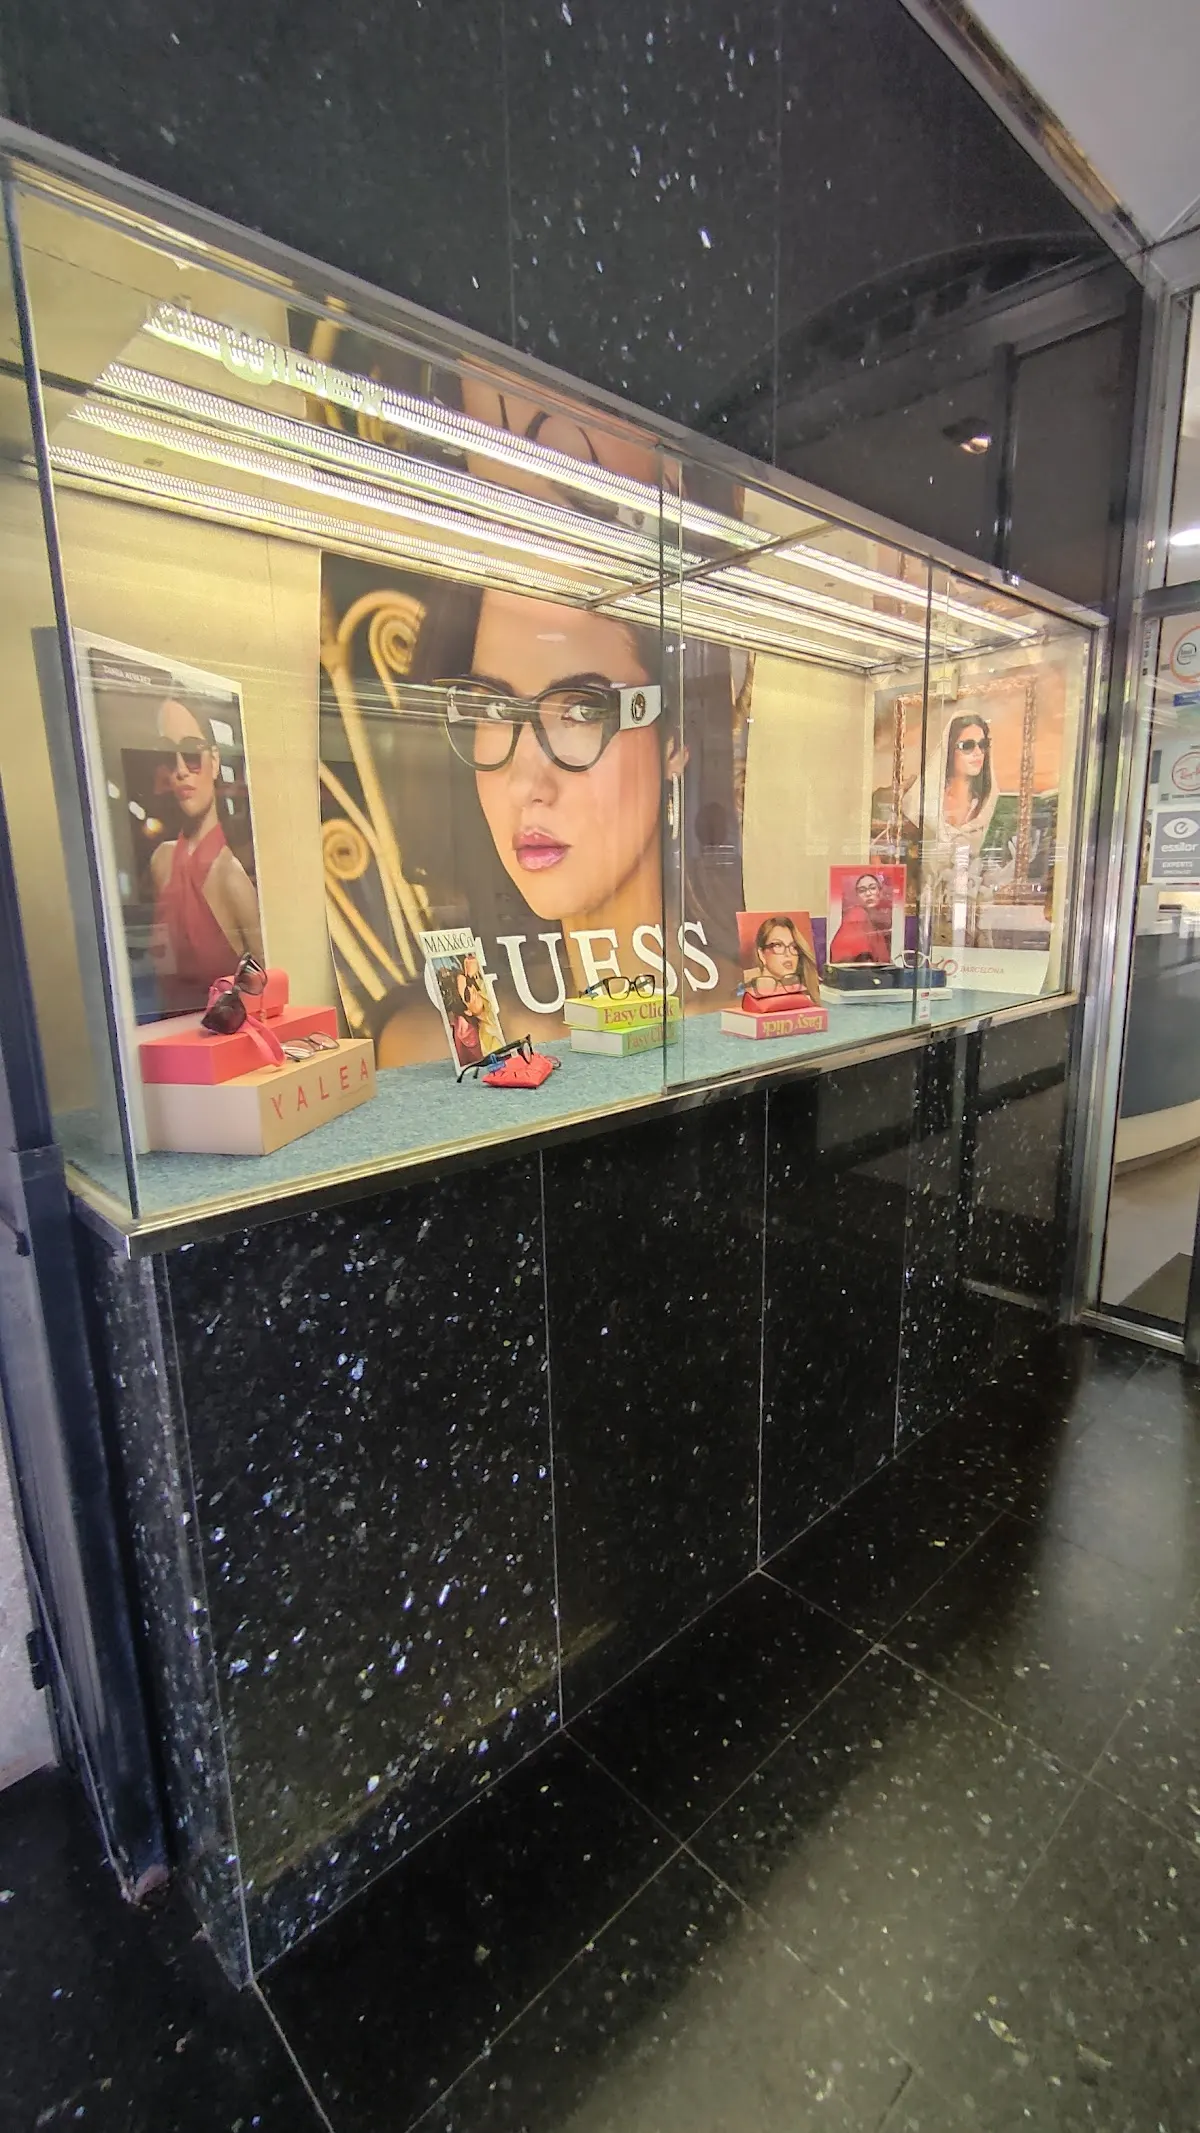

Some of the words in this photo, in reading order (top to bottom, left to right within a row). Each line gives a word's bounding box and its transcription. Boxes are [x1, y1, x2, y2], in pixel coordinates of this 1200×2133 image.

[1161, 842, 1199, 853] essilor
[425, 921, 719, 1014] GUESS
[604, 1008, 636, 1025] Easy
[640, 1001, 674, 1019] Click
[796, 1014, 823, 1031] Easy
[763, 1019, 794, 1037] Click
[270, 1058, 369, 1119] YALEA
